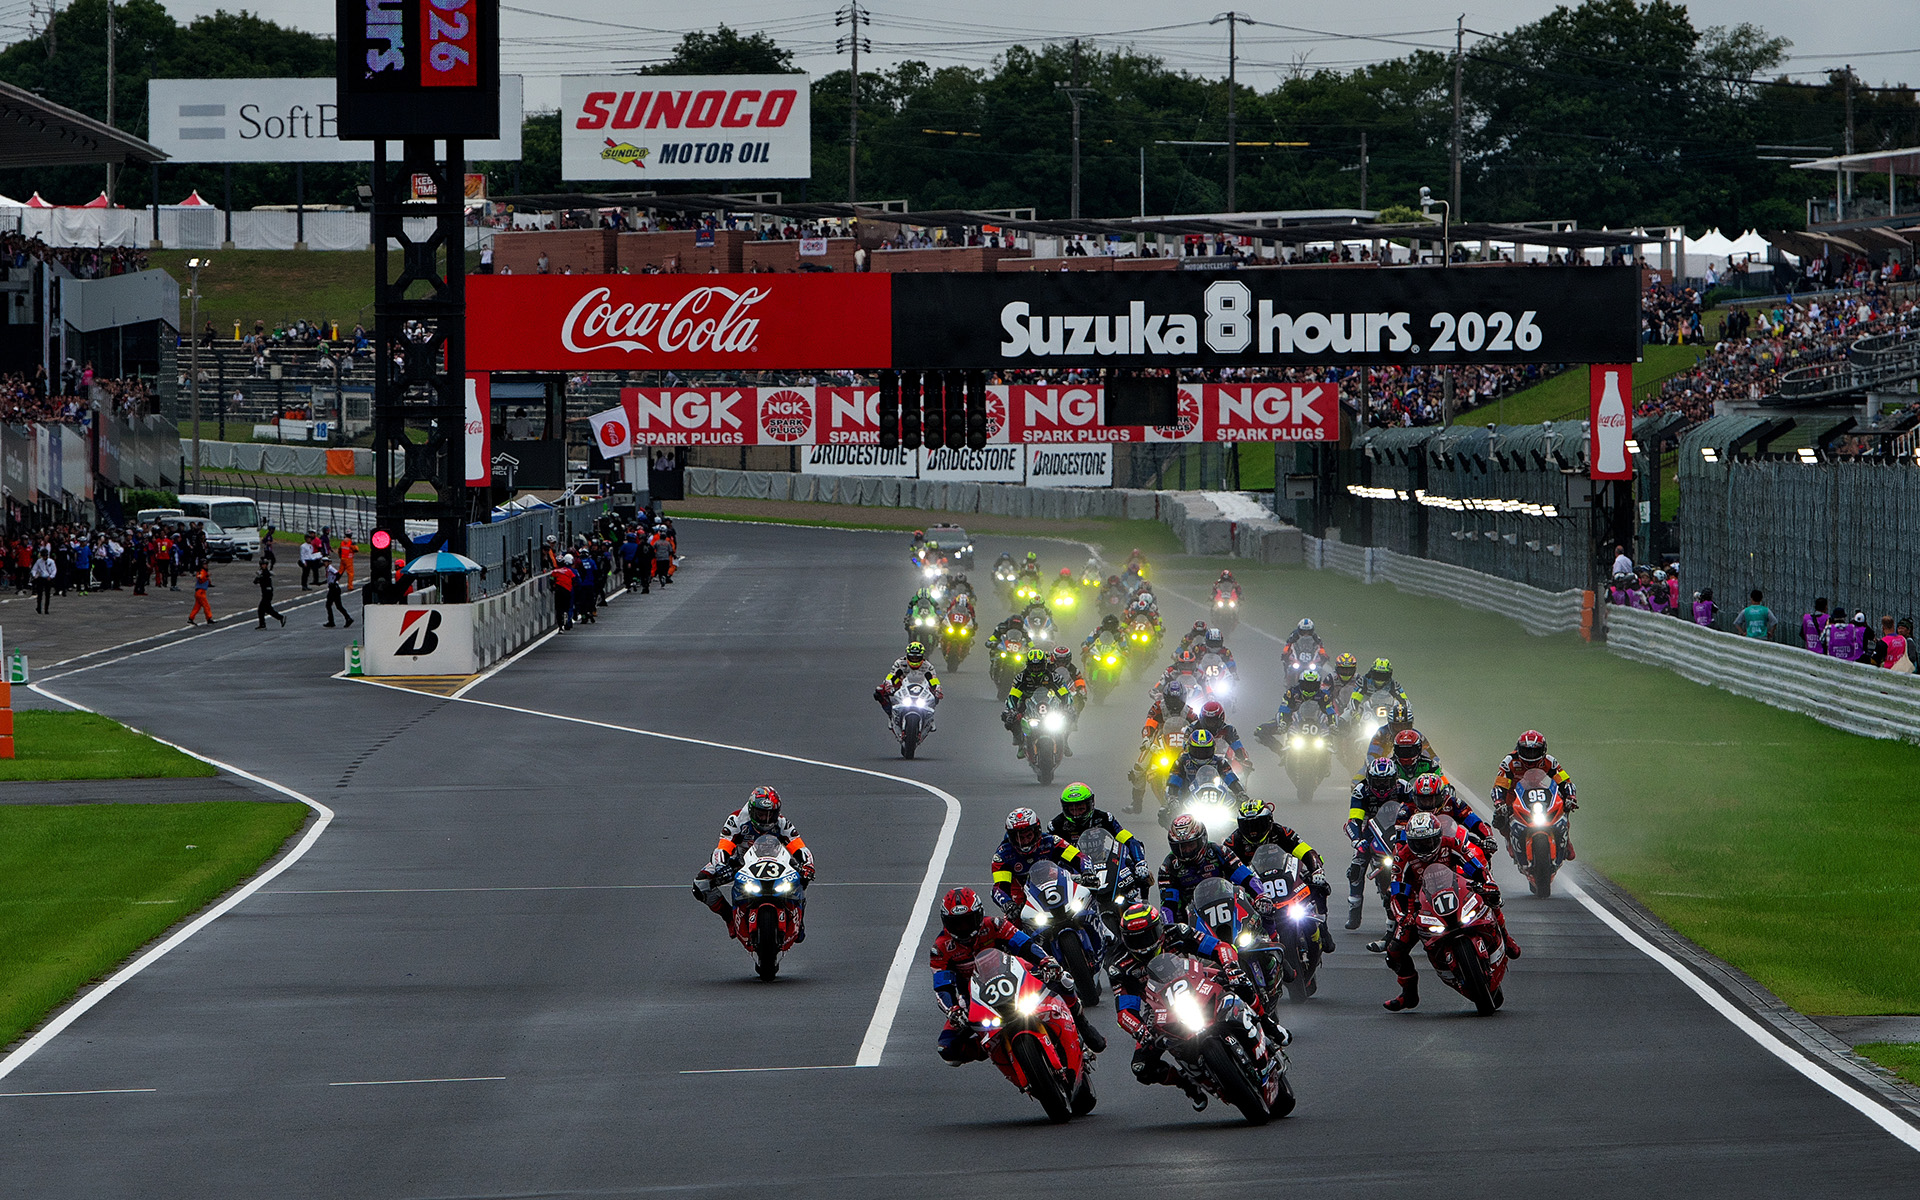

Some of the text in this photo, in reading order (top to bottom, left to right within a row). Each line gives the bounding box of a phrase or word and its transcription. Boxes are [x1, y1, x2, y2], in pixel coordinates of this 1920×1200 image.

[576, 89, 797, 129] SUNOCO
[238, 104, 338, 140] SoftB
[603, 149, 647, 159] SUNOCO
[659, 142, 770, 163] MOTOR OIL
[415, 177, 433, 185] KEB
[561, 286, 772, 354] Coca-Cola
[1000, 300, 1198, 358] Suzuka
[1203, 280, 1252, 354] 8
[1429, 310, 1543, 352] 2026
[637, 390, 743, 430] NGK
[768, 402, 804, 415] NGK
[1218, 385, 1325, 426] NGK
[316, 422, 327, 438] 18
[769, 418, 803, 426] SPARK
[635, 431, 744, 445] SPARK PLUGS
[770, 426, 803, 435] PLUGS
[1022, 428, 1131, 443] SPARK PLUGS
[1216, 427, 1325, 441] SPARK PLUGS
[926, 446, 1016, 471] BRIDGESTONE
[1031, 449, 1106, 477] BRIDGESTONE
[954, 614, 964, 623] 93
[1033, 617, 1041, 626] 3
[1206, 665, 1219, 677] 45
[1038, 704, 1048, 716] 8
[1376, 706, 1387, 718] 6
[1302, 724, 1318, 736] 50
[1169, 733, 1184, 747] 25
[1528, 789, 1546, 803] 95
[755, 862, 780, 878] 73
[1045, 887, 1061, 905] 5
[1263, 878, 1289, 899] 99
[1434, 893, 1454, 913] 17
[1204, 902, 1232, 927] 76
[985, 978, 1015, 1005] 30
[1165, 979, 1189, 1007] 12
